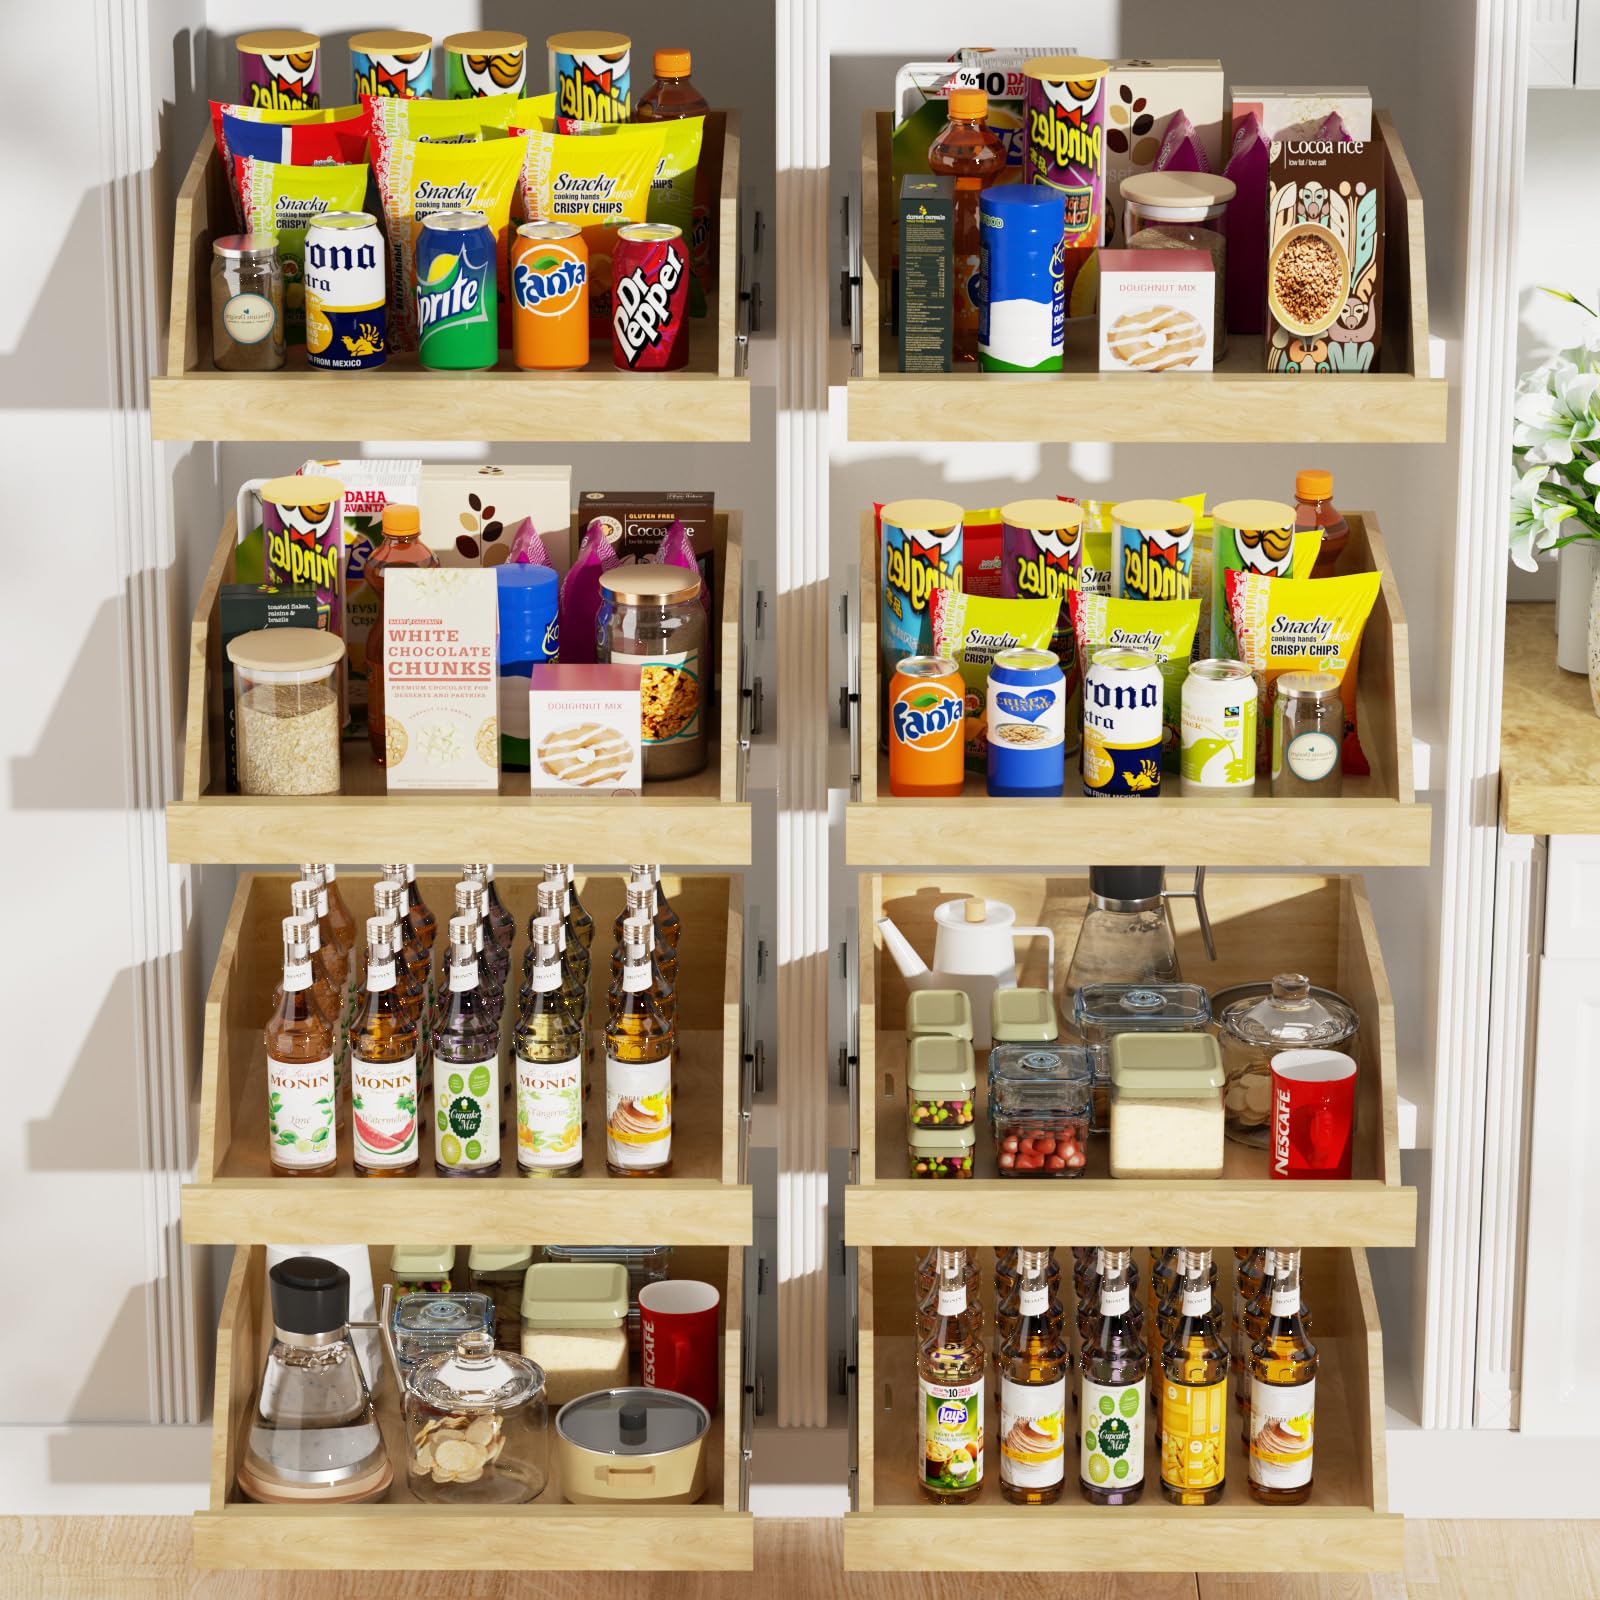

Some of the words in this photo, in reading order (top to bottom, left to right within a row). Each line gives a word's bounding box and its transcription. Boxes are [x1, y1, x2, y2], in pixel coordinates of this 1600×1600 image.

[1288, 140, 1333, 155] Cocoa
[1337, 140, 1364, 155] rice
[553, 173, 616, 199] Snacky
[650, 179, 673, 189] HIPS
[415, 181, 477, 207] Snacky
[580, 192, 600, 200] hands
[275, 195, 328, 213] Snacky
[415, 201, 440, 209] cooking
[553, 202, 589, 213] CRISPY
[592, 202, 623, 213] CHIPS
[276, 219, 307, 229] CRISPY
[513, 260, 586, 308] Fanta
[616, 266, 650, 312] Dr
[1119, 283, 1175, 293] DOUGHNUT
[1177, 283, 1198, 293] MIX
[613, 245, 683, 363] Pepper
[313, 356, 331, 367] FROM
[332, 358, 361, 367] MEXICO
[344, 491, 387, 503] DAHA
[627, 523, 668, 537] Cocoa
[267, 603, 290, 611] toasted
[1271, 616, 1333, 641] Snacky
[388, 630, 460, 642] WHITE
[965, 629, 1019, 648] Snacky
[1109, 629, 1162, 650] Snacky
[1271, 635, 1296, 643] cooking
[388, 646, 491, 657] CHOCOLATE
[1271, 644, 1306, 655] CRISPY
[1309, 644, 1339, 655] CHIPS
[388, 661, 491, 675] CHUNKS
[547, 702, 601, 711] DOUGHNUT
[604, 702, 623, 711] MIX
[893, 697, 963, 741] Fanta
[271, 1073, 329, 1089] MONIN
[355, 1073, 411, 1089] MONIN
[520, 1073, 577, 1089] MONIN
[450, 1108, 479, 1122] Cupcake
[461, 1119, 477, 1131] Mix
[1099, 1429, 1129, 1444] Cupcake
[1110, 1440, 1126, 1451] Mix
